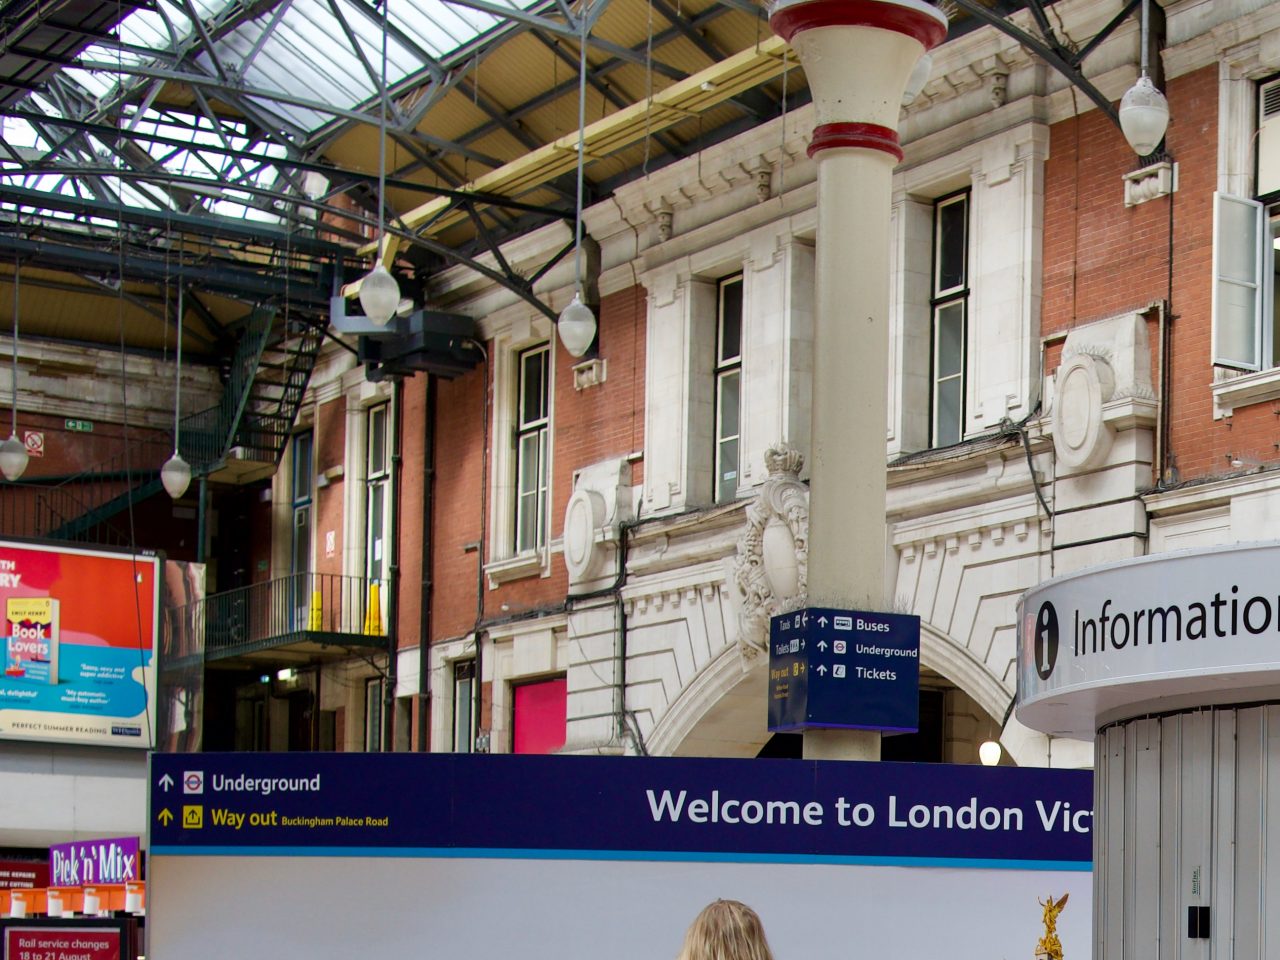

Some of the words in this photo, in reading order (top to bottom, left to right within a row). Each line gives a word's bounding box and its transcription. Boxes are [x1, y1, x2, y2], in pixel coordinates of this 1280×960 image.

[12, 623, 46, 639] Book
[856, 619, 890, 632] Buses
[8, 637, 49, 655] Lovers
[856, 644, 918, 658] Underground
[856, 667, 897, 681] Tickets
[12, 722, 42, 731] PERFECT
[43, 724, 74, 733] SUMMER
[75, 725, 107, 734] READING
[212, 774, 320, 795] Underground
[646, 789, 823, 826] Welcome
[835, 797, 875, 827] to
[888, 796, 1023, 831] London
[1036, 800, 1094, 833] Vic
[211, 809, 245, 830] Way
[250, 810, 277, 826] out
[281, 817, 334, 828] Buckingham
[335, 817, 364, 827] Palace
[365, 817, 388, 827] Road
[53, 845, 79, 884] Pick
[99, 843, 134, 881] Mix
[19, 938, 36, 948] Rail
[38, 939, 69, 949] service
[71, 939, 109, 951] changes
[19, 952, 30, 960] 18
[32, 953, 42, 960] to
[44, 952, 56, 960] 21
